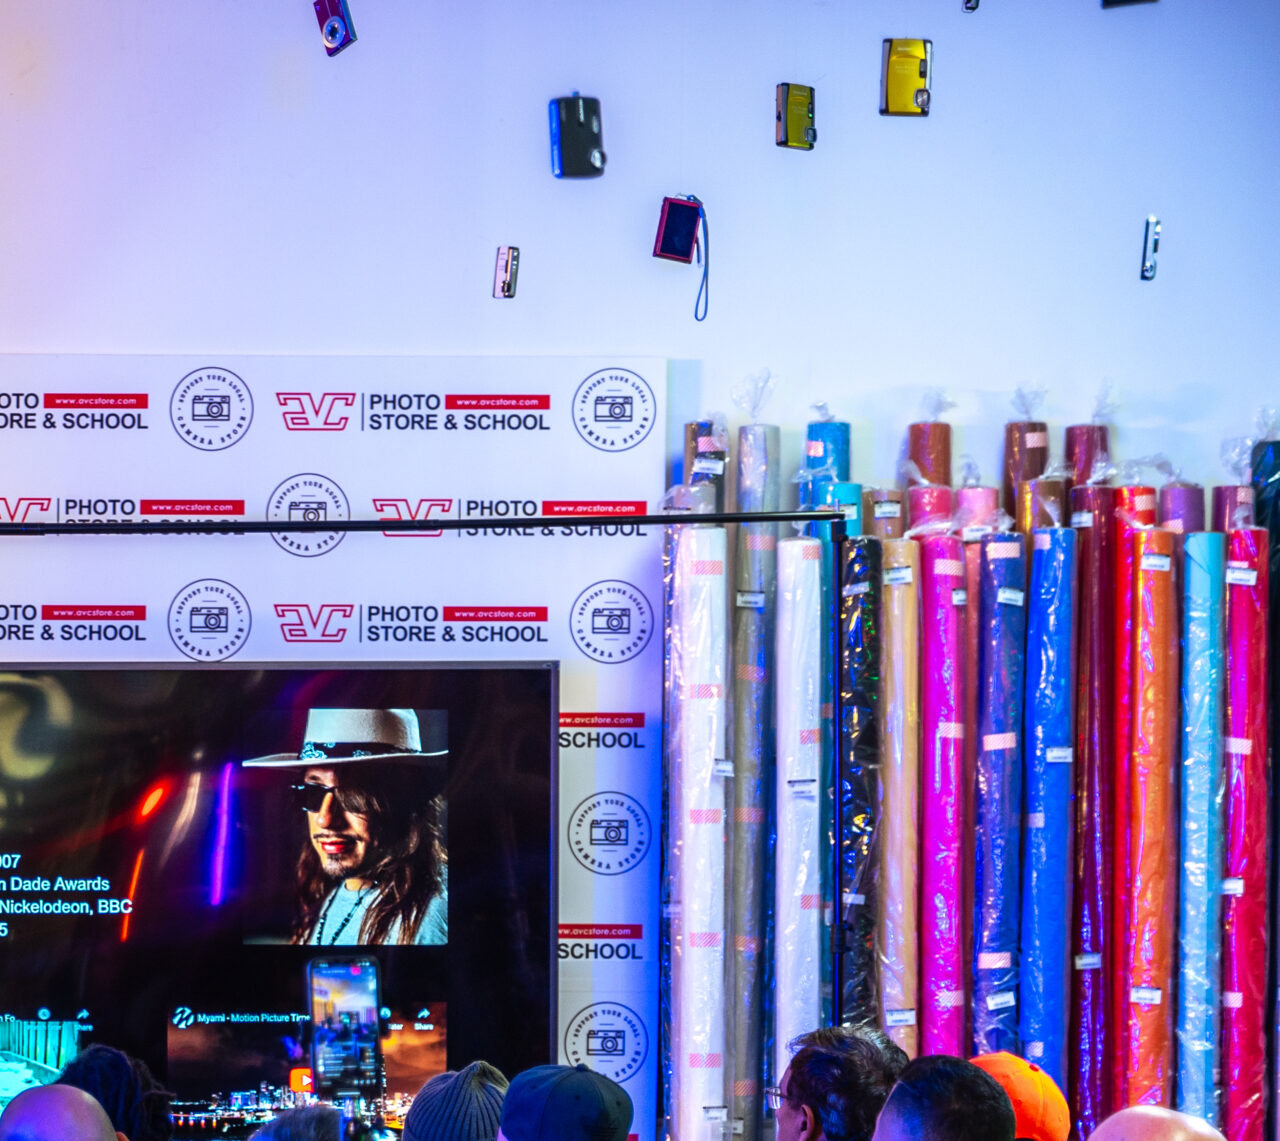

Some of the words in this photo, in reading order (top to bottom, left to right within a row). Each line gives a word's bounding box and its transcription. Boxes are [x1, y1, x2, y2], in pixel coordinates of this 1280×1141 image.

[178, 375, 205, 404] SUPPORT
[206, 374, 228, 384] YOUR
[228, 380, 247, 404] LOCAL
[580, 376, 607, 405] SUPPORT
[608, 375, 630, 385] YOUR
[630, 381, 649, 405] LOCAL
[55, 397, 137, 405] www.avcstore.com
[369, 393, 441, 411] PHOTO
[456, 398, 539, 407] www.avcstore.com
[42, 412, 57, 429] &
[62, 412, 149, 430] SCHOOL
[369, 413, 438, 431] STORE
[443, 413, 458, 431] &
[463, 413, 551, 431] SCHOOL
[176, 415, 214, 446] CAMERA
[219, 415, 248, 444] STORE
[578, 416, 616, 447] CAMERA
[621, 416, 650, 445] STORE
[65, 498, 136, 516] PHOTO
[151, 503, 233, 511] www.avcstore.com
[466, 500, 537, 517] PHOTO
[553, 504, 636, 513] www.avcstore.com
[52, 609, 135, 617] www.avcstore.com
[367, 605, 439, 623] PHOTO
[454, 610, 537, 618] www.avcstore.com
[40, 624, 55, 641] &
[60, 624, 147, 641] SCHOOL
[367, 625, 436, 642] STORE
[441, 625, 456, 642] &
[461, 625, 548, 643] SCHOOL
[559, 731, 646, 748] SCHOOL
[10, 876, 51, 891] Dade
[53, 876, 111, 891] Awards
[97, 898, 133, 914] BBC
[558, 942, 644, 960] SCHOOL
[197, 1013, 226, 1024] Myami
[231, 1013, 260, 1022] Motion
[261, 1013, 290, 1022] Picture
